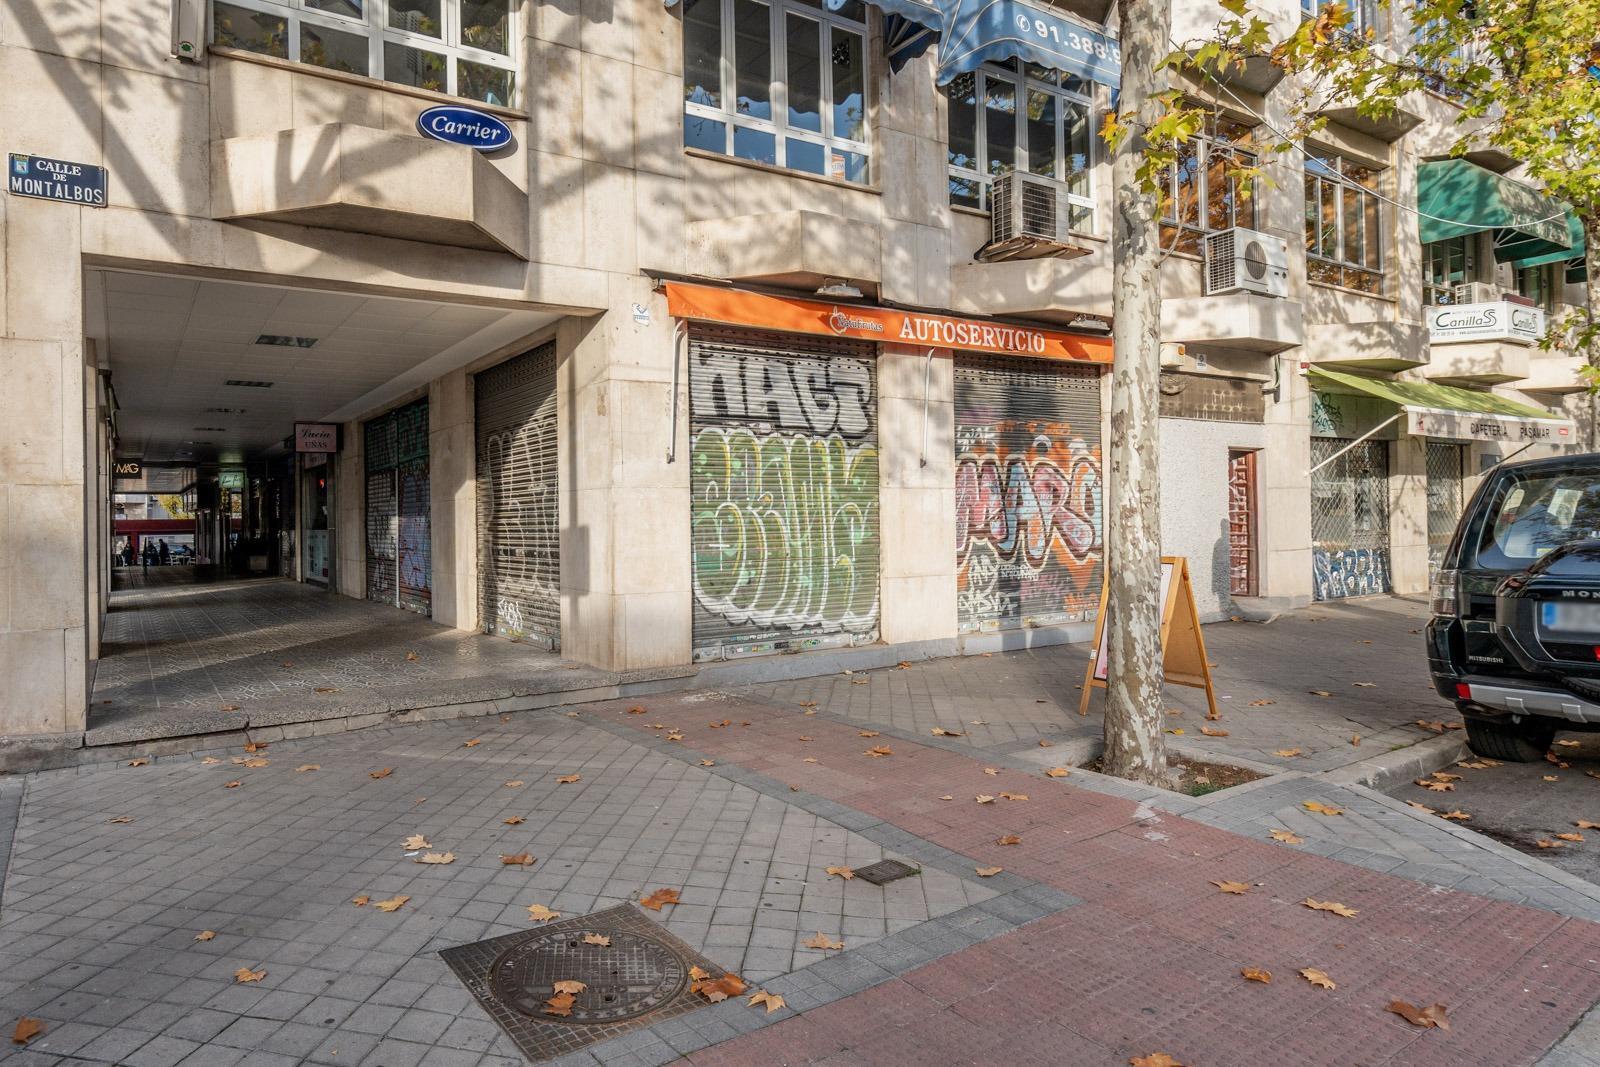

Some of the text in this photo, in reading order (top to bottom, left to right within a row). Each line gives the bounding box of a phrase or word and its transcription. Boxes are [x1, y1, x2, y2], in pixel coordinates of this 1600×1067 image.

[432, 116, 501, 140] Carrier
[36, 160, 81, 176] CALLE
[53, 173, 67, 182] DE
[11, 176, 103, 203] MONTALBOS
[899, 317, 1045, 352] AUTOSERVICIO
[1520, 426, 1550, 438] PASAMAR
[1468, 655, 1504, 664] MITSUBISHI
